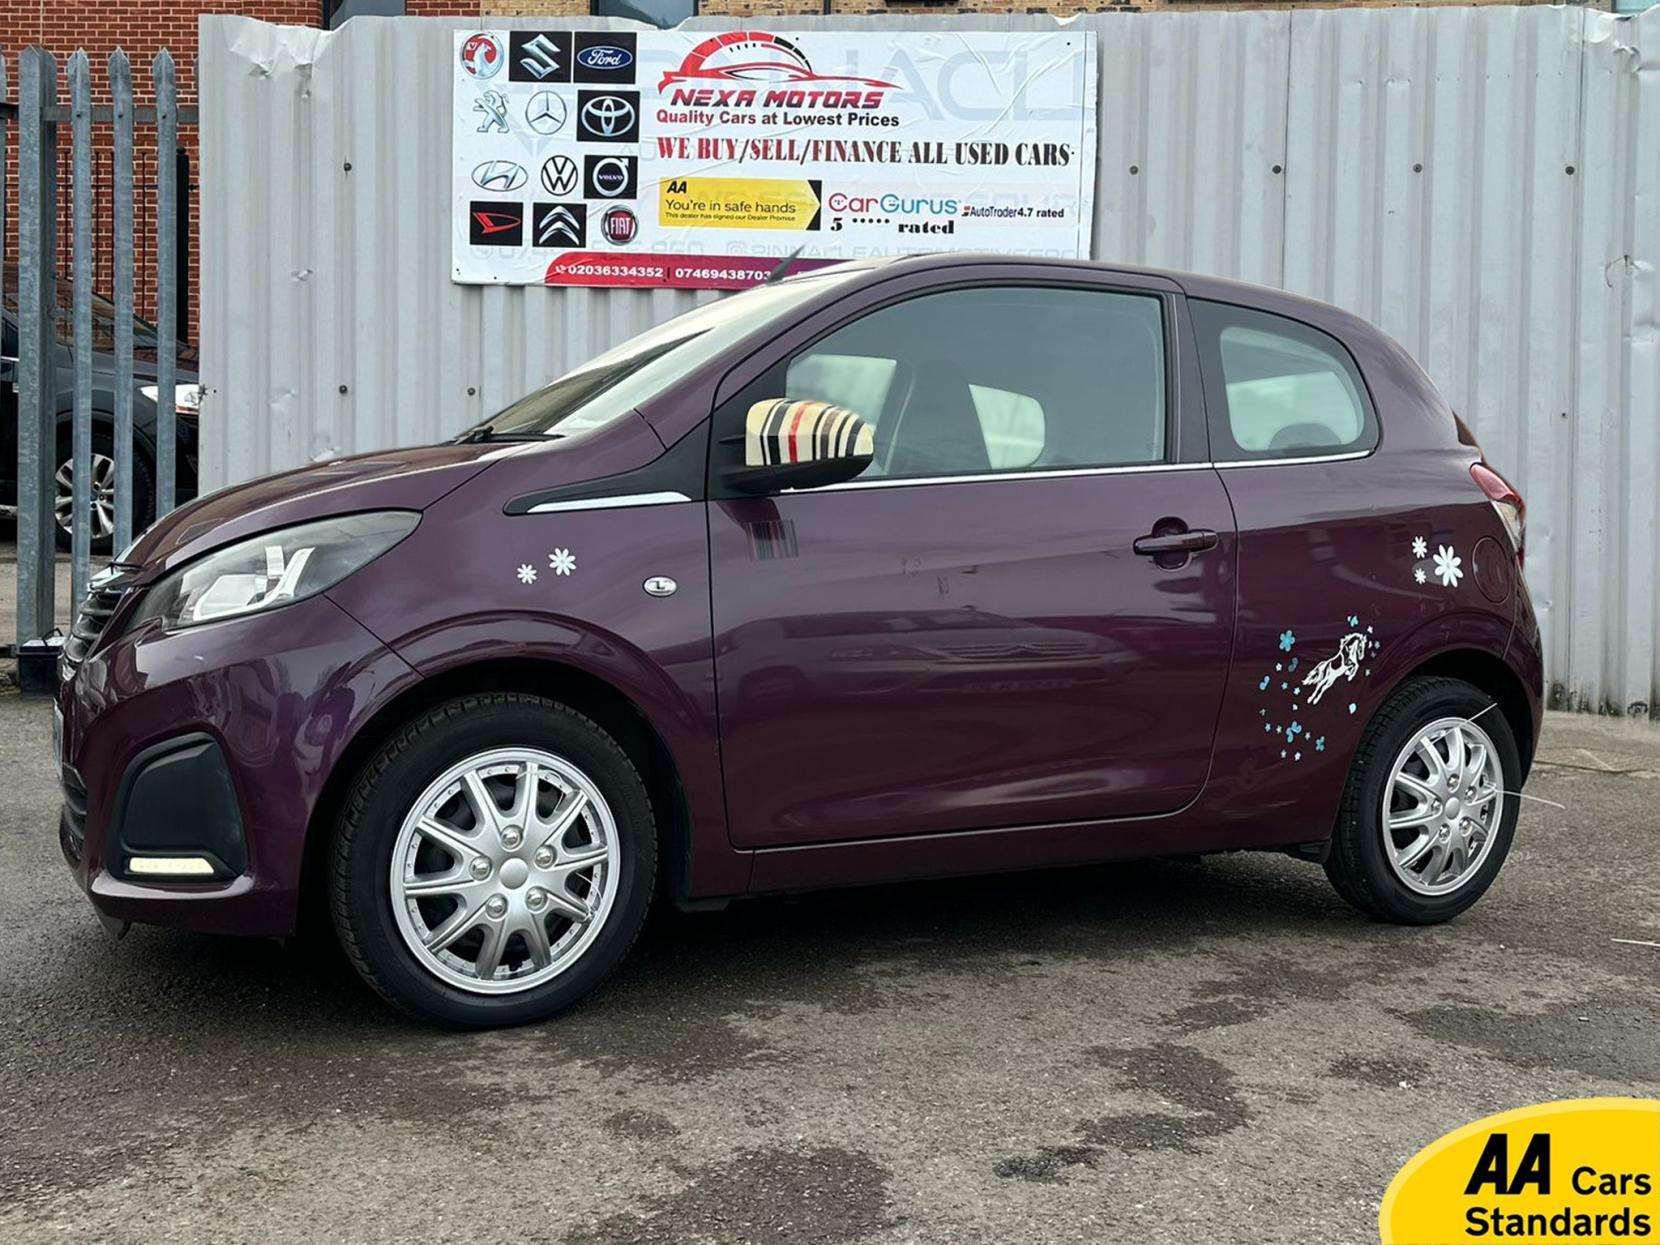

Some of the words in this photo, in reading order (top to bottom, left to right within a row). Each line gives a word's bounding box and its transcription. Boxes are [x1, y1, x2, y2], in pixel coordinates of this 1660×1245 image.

[587, 49, 622, 66] Ford
[670, 89, 757, 107] NEXA
[763, 91, 884, 109] MOTORS
[656, 109, 714, 126] Quality
[719, 110, 756, 125] Cars
[761, 112, 778, 125] at
[783, 111, 842, 127] Lowest
[847, 112, 900, 127] Prices
[657, 137, 690, 159] WE
[908, 141, 948, 164] ALL
[955, 142, 1009, 165] USED
[666, 181, 688, 194] AA
[665, 199, 706, 211] You're
[709, 200, 721, 211] in
[724, 201, 752, 212] safe
[755, 202, 796, 213] hands
[828, 193, 958, 215] CarGurus
[1036, 208, 1065, 218] rated
[610, 217, 631, 234] FIAT
[830, 217, 843, 231] 5
[897, 220, 955, 234] rated
[567, 265, 664, 278] 02036334352
